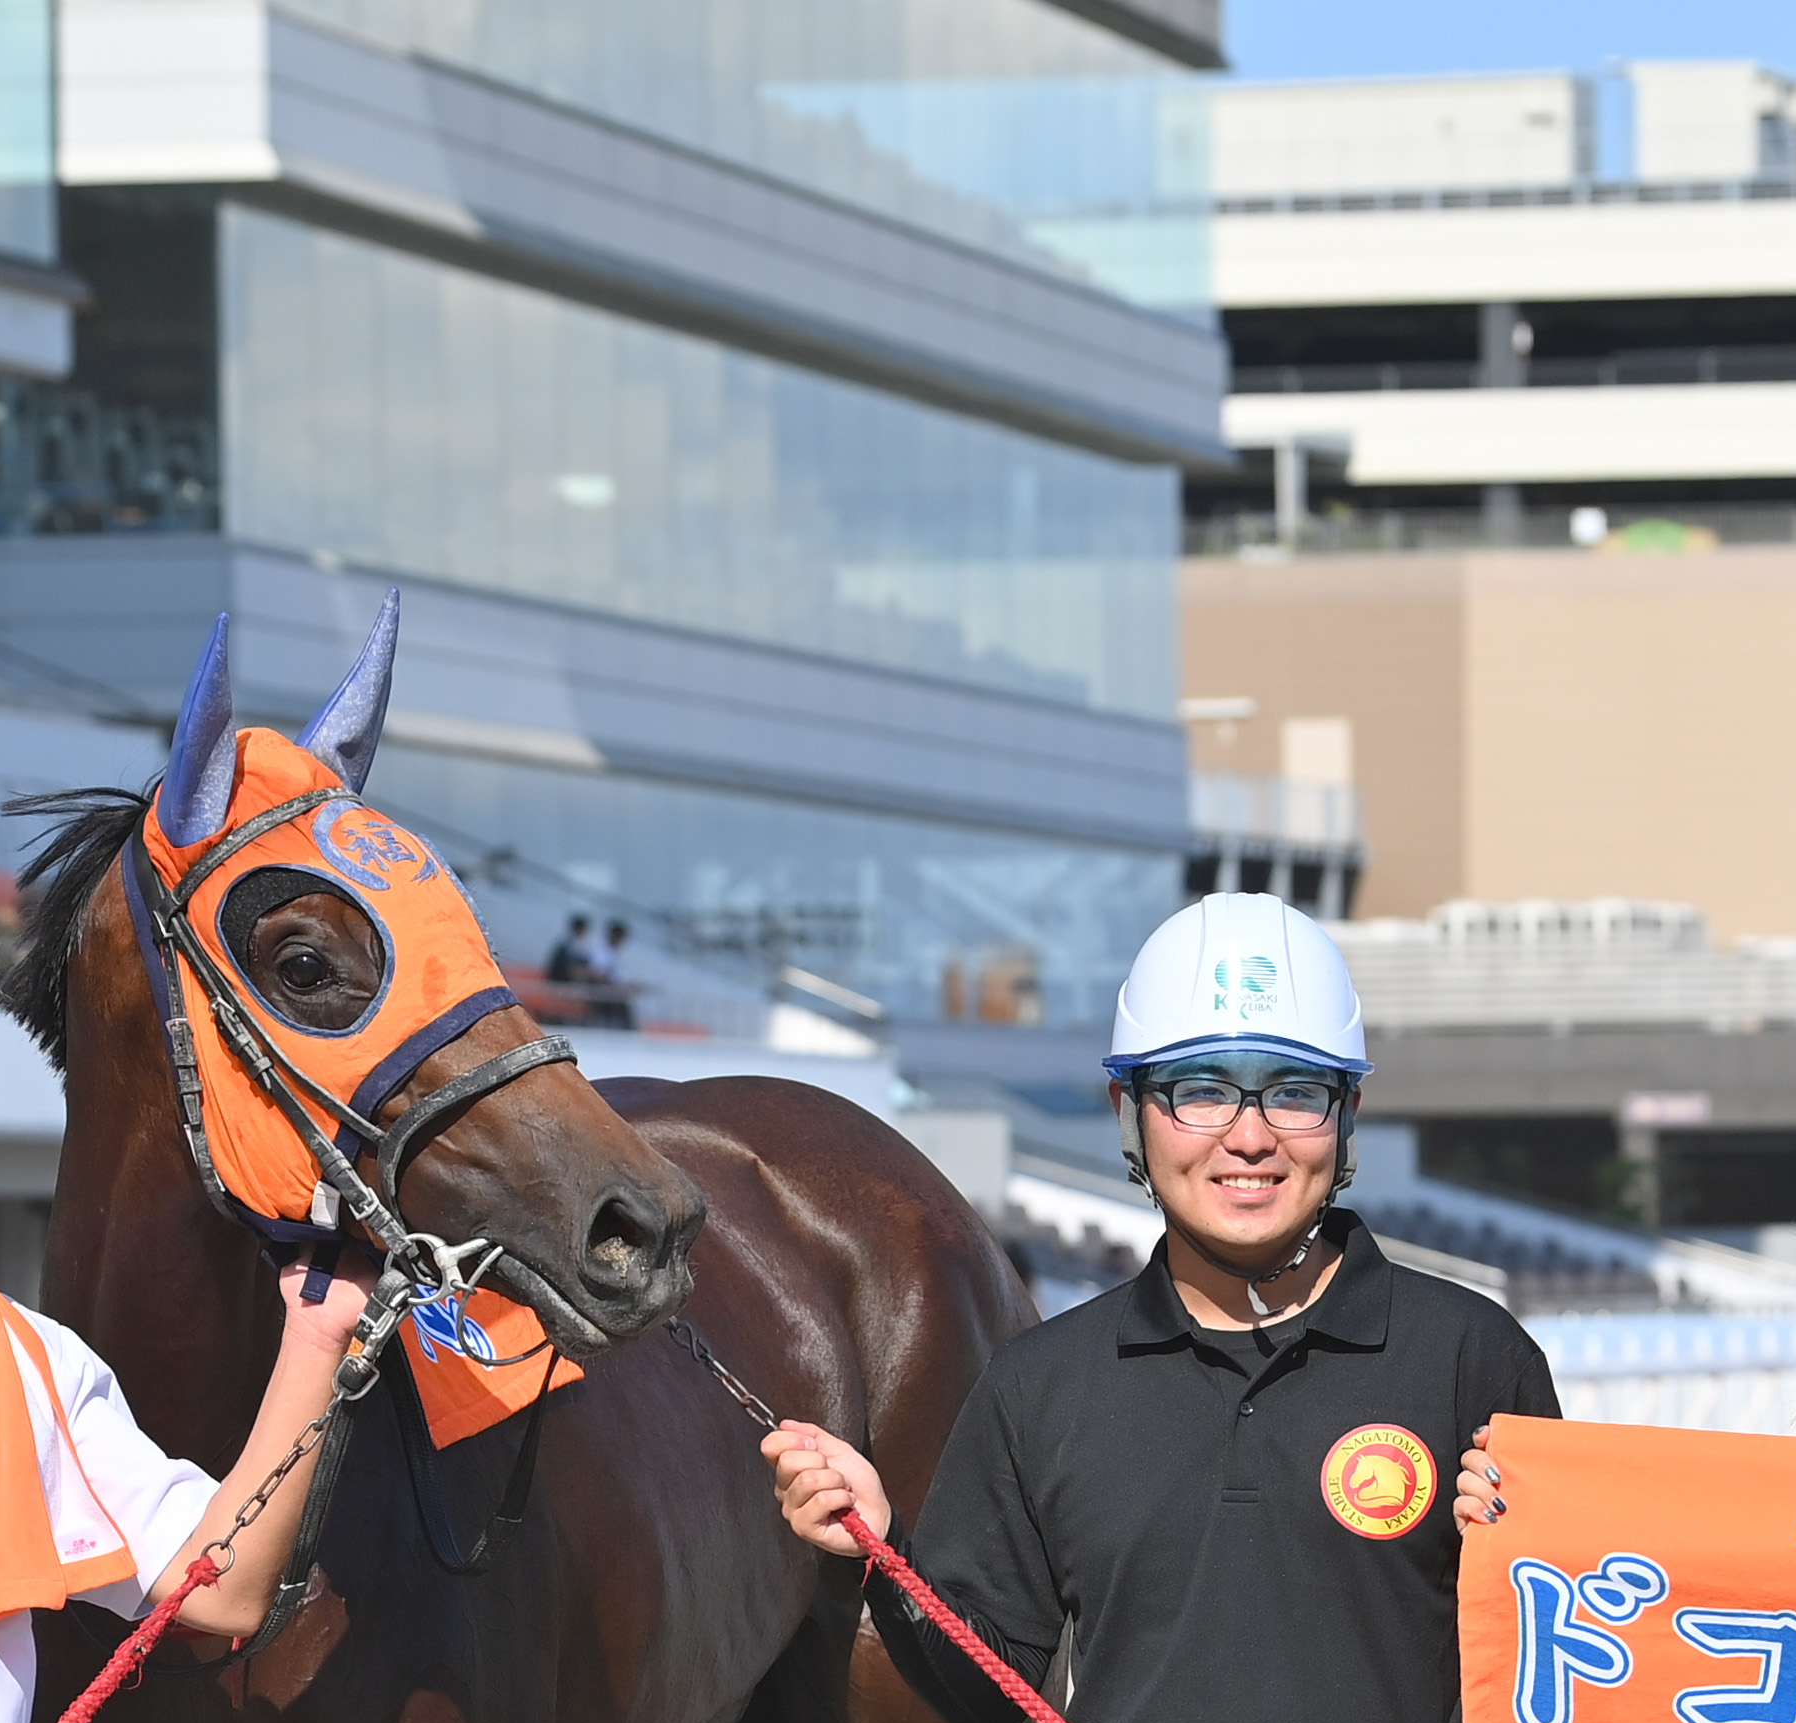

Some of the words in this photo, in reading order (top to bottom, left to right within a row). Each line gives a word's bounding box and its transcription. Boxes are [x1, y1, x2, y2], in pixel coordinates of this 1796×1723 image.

[1341, 1432, 1422, 1463] NAGATOMO
[1328, 1477, 1366, 1527] STABLE
[1384, 1485, 1427, 1530] YUTAKA
